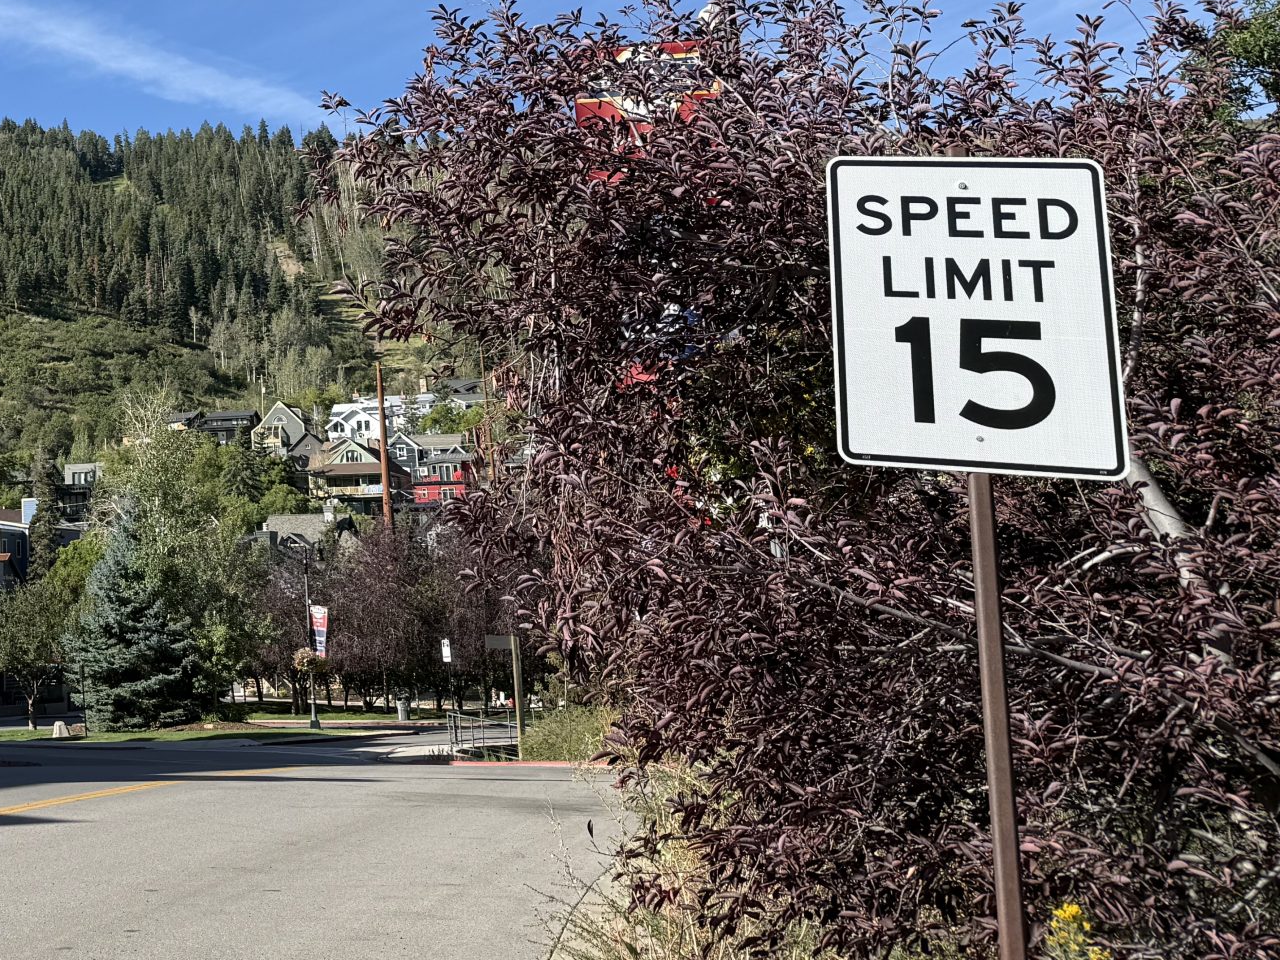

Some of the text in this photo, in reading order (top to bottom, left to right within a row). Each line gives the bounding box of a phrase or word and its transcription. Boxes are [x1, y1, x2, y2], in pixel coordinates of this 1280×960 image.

[855, 194, 1079, 240] SPEED
[882, 255, 1055, 303] LIMIT
[894, 316, 1057, 430] 15
